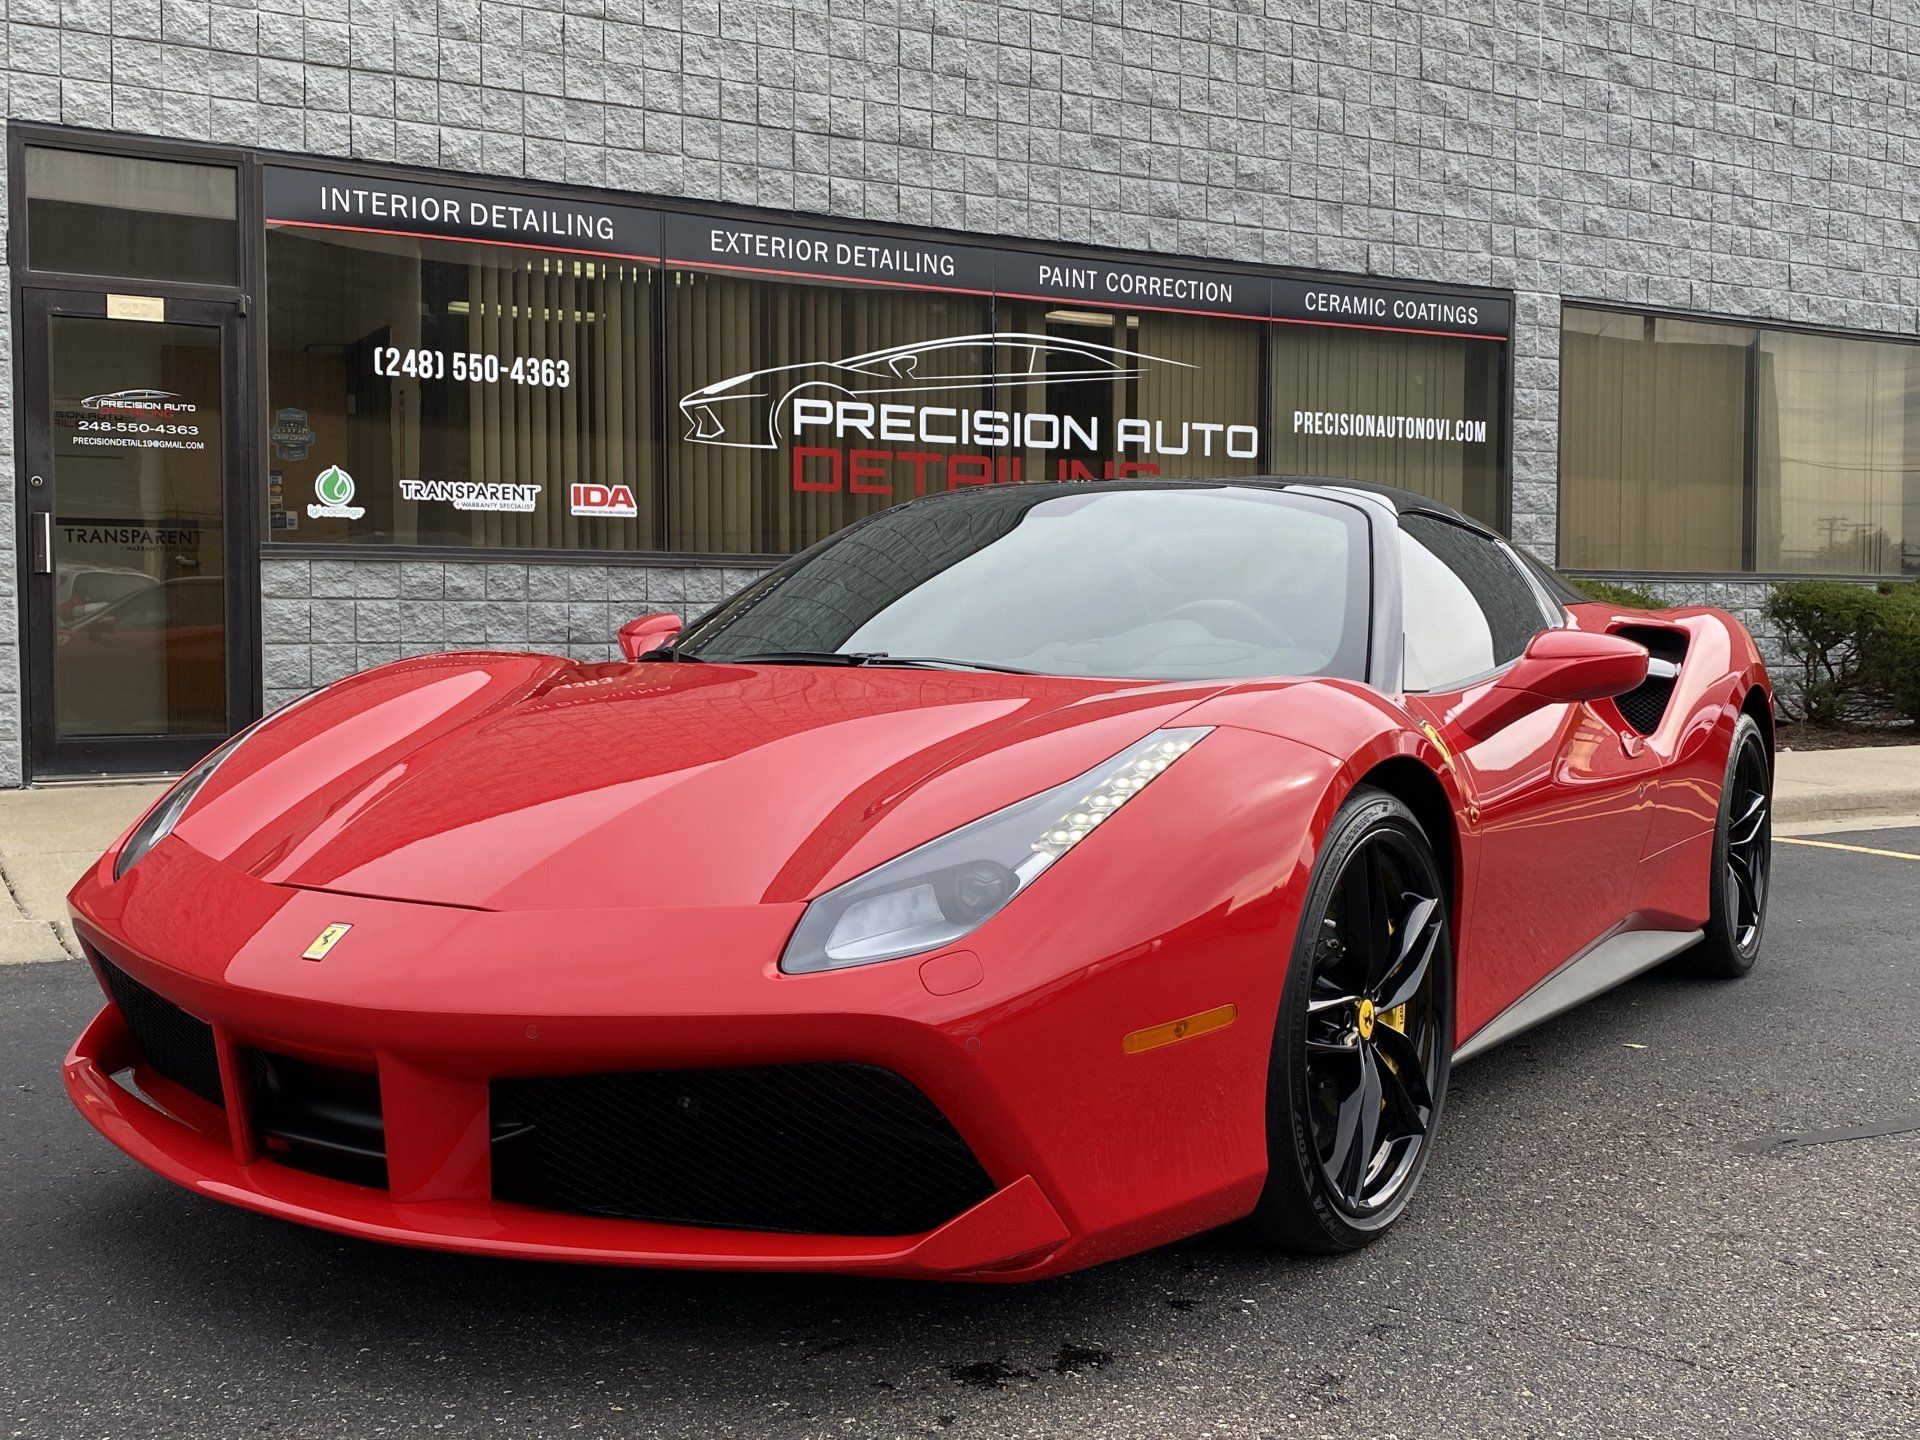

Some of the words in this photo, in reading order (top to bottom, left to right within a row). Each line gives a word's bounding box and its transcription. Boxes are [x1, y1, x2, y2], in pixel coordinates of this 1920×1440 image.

[320, 187, 461, 223] INTERIOR
[470, 203, 614, 240] DETAILING
[710, 229, 828, 263] EXTERIOR
[836, 244, 955, 276] DETAILING
[1039, 265, 1098, 290] PAINT
[1106, 273, 1232, 303] CORRECTION
[1304, 291, 1386, 317] CERAMIC
[1393, 300, 1479, 325] COATINGS
[374, 346, 444, 379] (248)
[453, 352, 570, 388] 550-4363
[101, 400, 161, 410] PRECISION
[164, 403, 196, 412] AUTO
[78, 421, 199, 435] 248-550-4363
[793, 398, 1098, 451] PRECISION
[1117, 418, 1258, 459] AUTO
[1293, 410, 1486, 443] PRECISIONAUTONOVI.COM
[72, 436, 204, 449] PRECISIONDETAIL19@GMAIL.COM
[402, 482, 537, 501] TRANSPARENT
[573, 486, 635, 508] IDA
[322, 508, 361, 517] coatings
[461, 501, 498, 509] WARRANTY
[64, 528, 204, 545] TRANSPARENT
